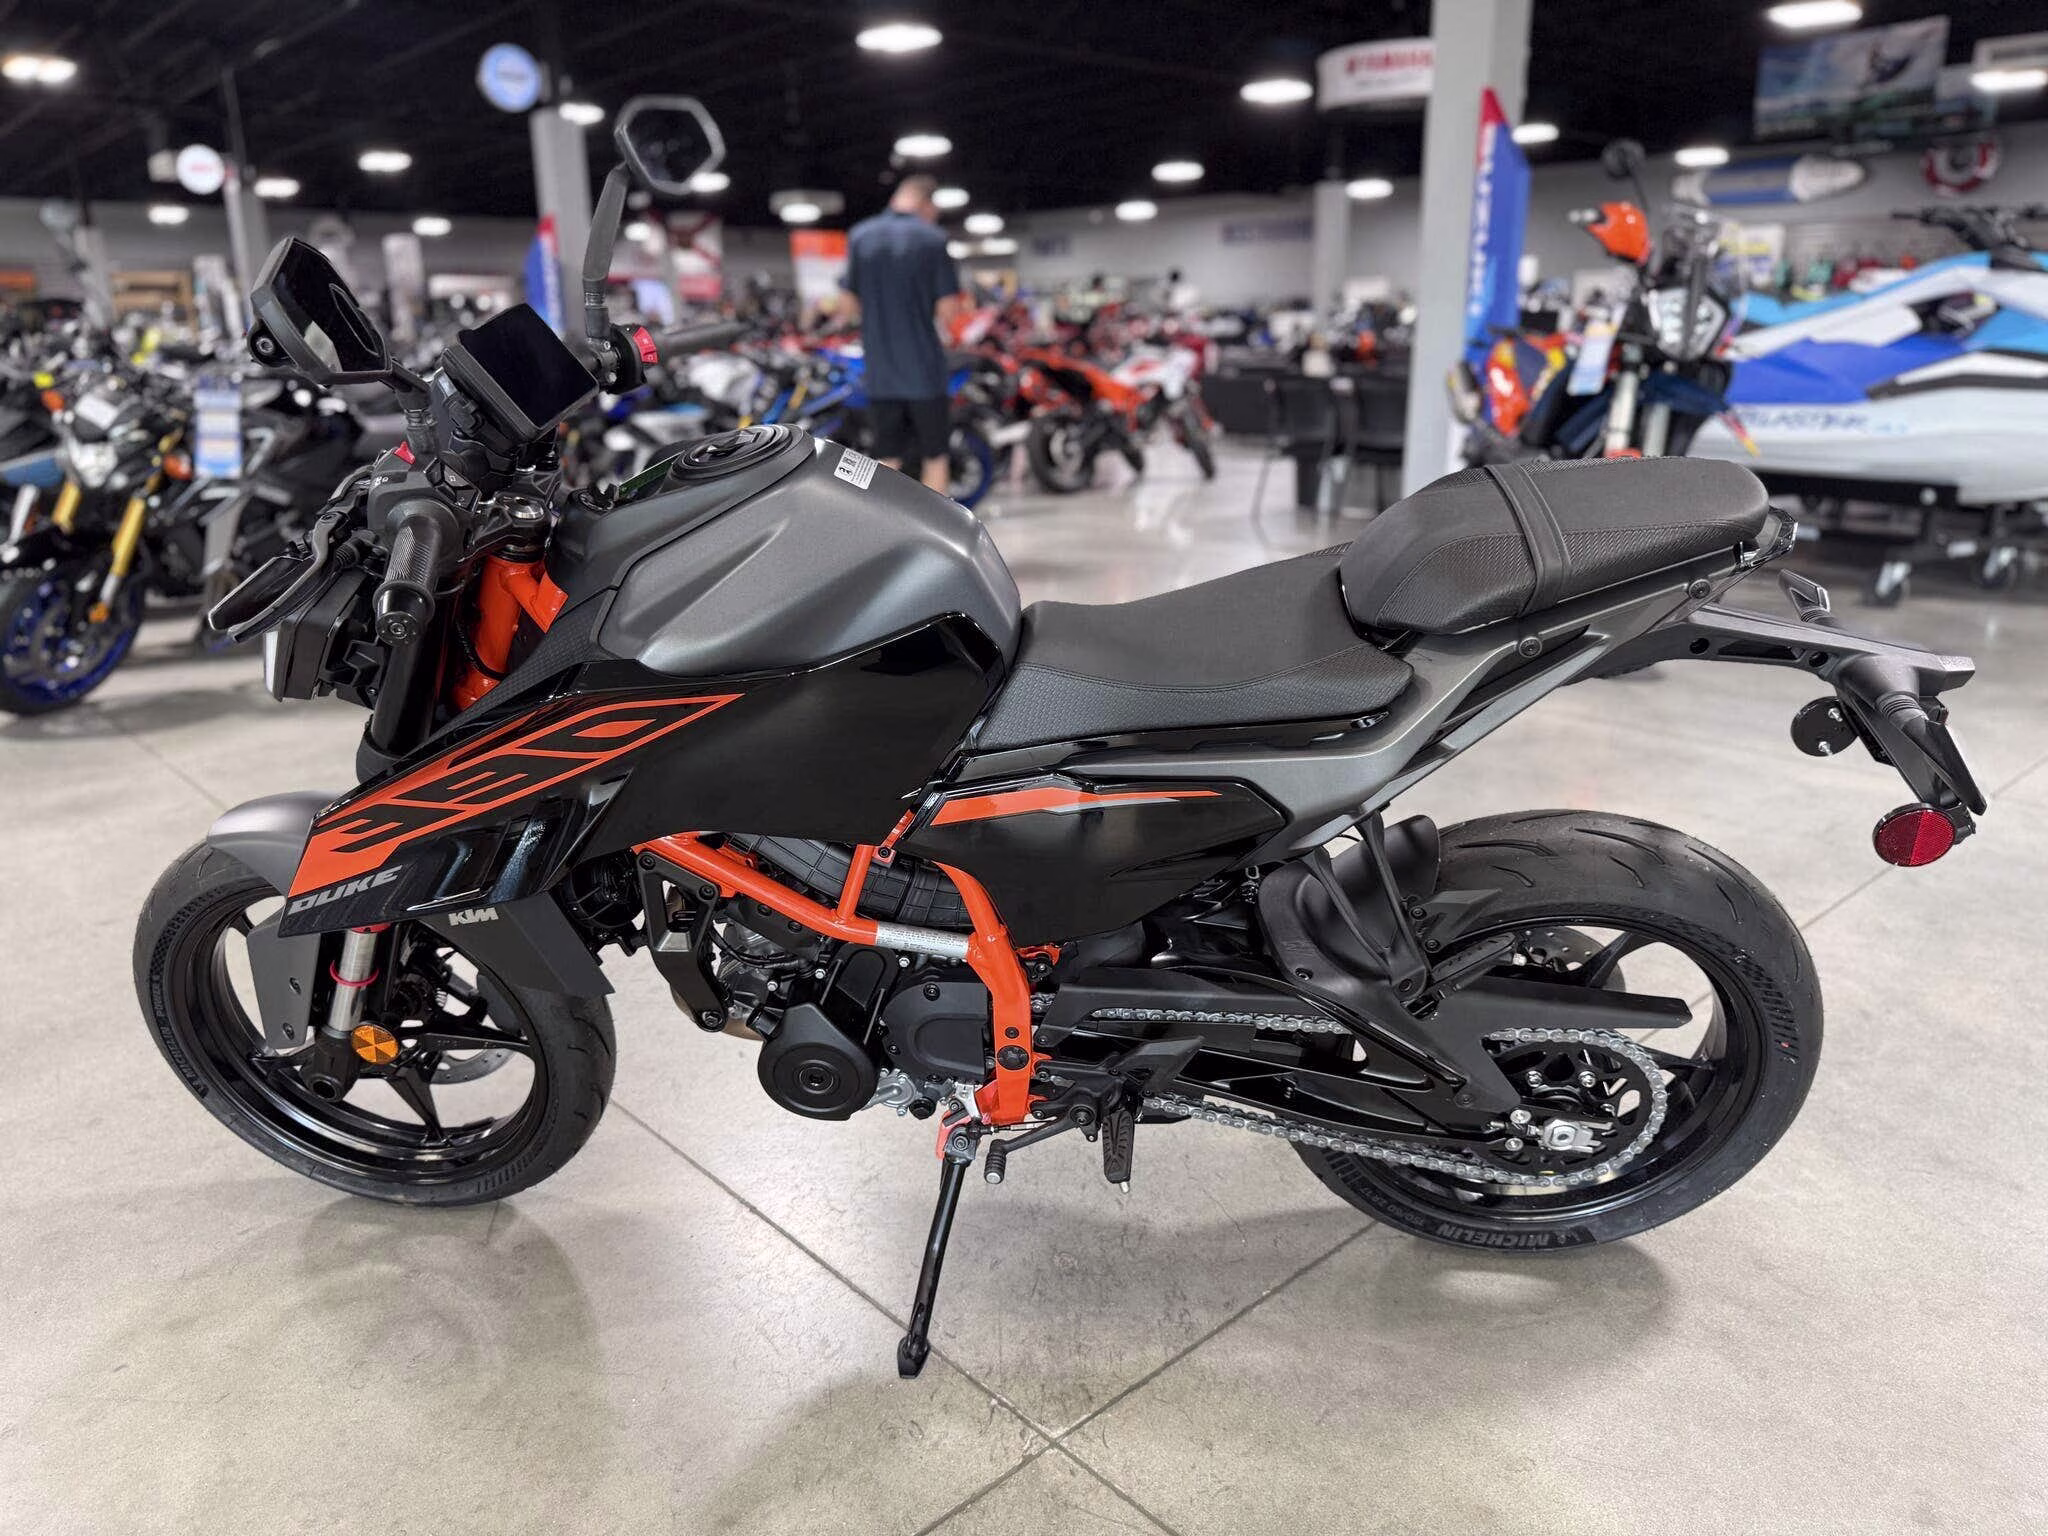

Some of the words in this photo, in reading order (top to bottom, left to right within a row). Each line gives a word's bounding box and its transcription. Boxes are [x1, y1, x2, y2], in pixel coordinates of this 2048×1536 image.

[287, 864, 403, 915] DUKE
[448, 907, 499, 926] KTM
[1437, 1222, 1550, 1248] MICHELIN
